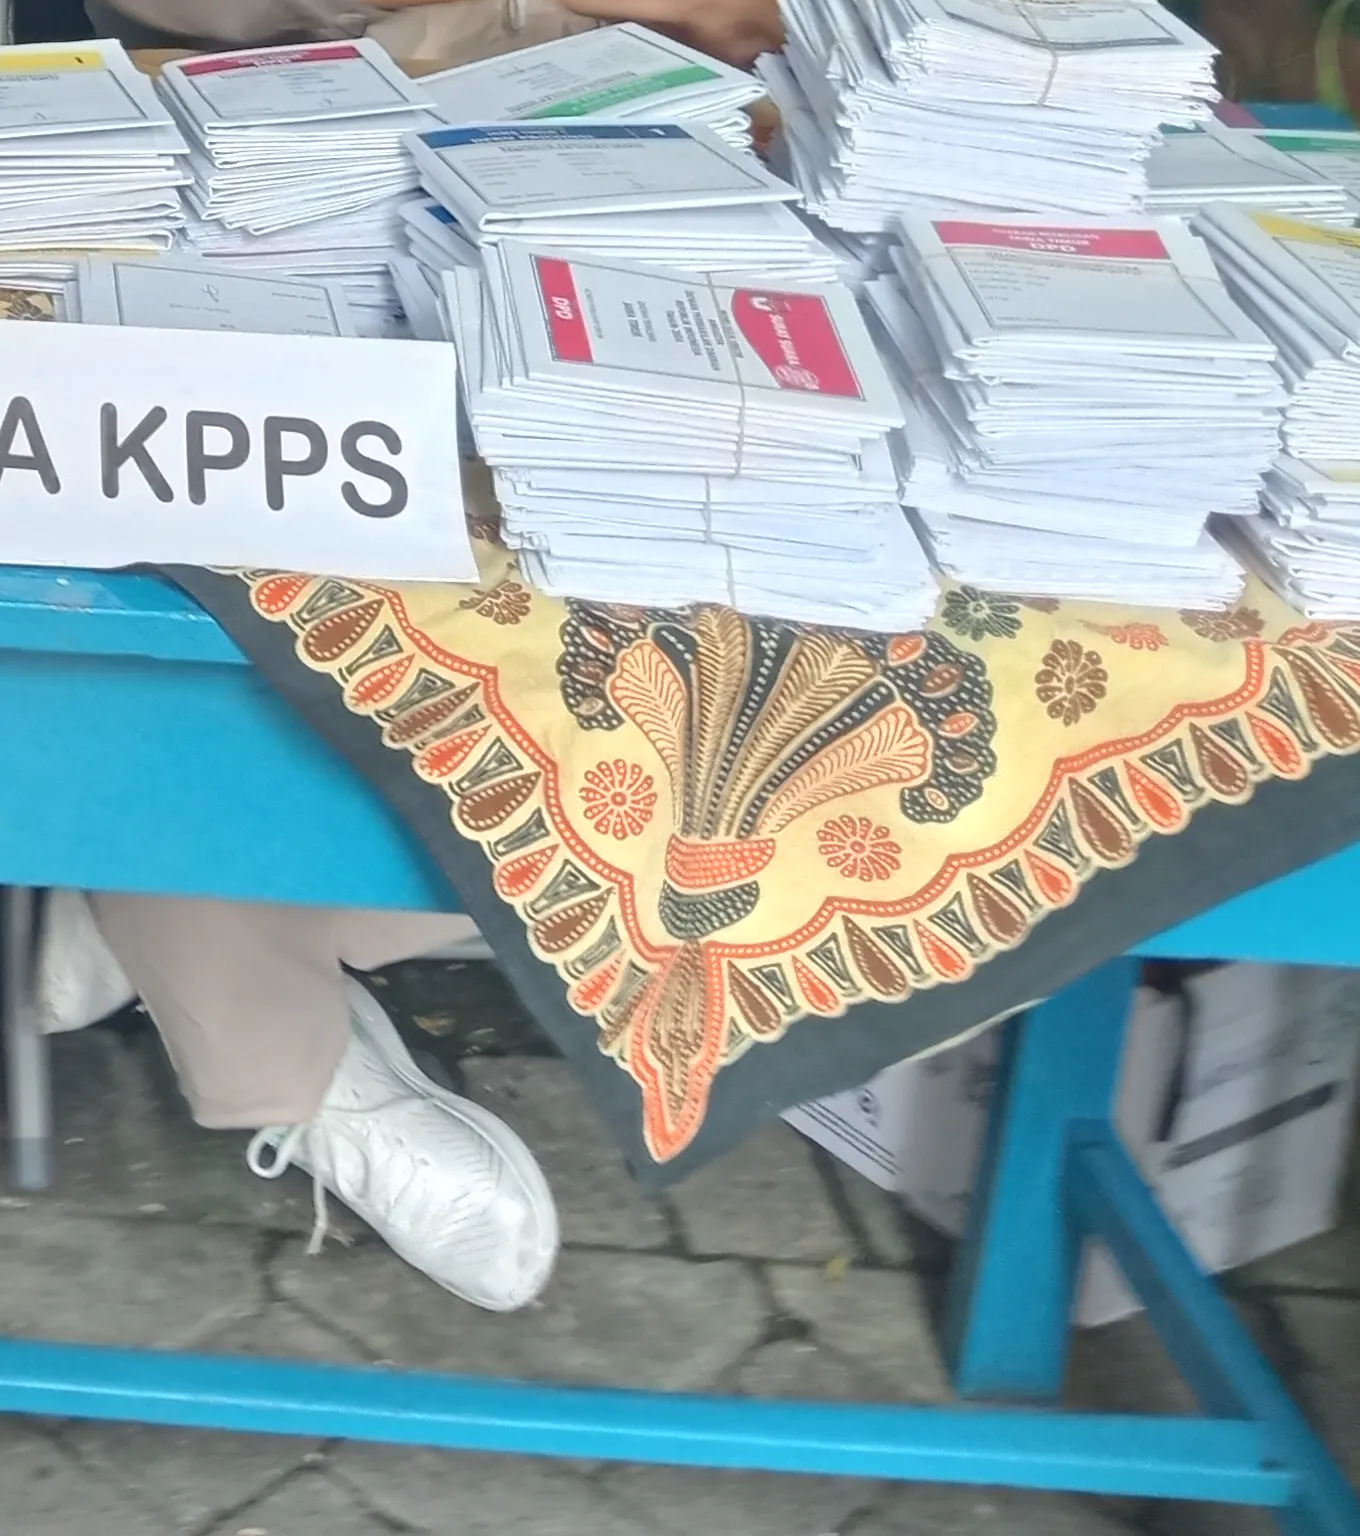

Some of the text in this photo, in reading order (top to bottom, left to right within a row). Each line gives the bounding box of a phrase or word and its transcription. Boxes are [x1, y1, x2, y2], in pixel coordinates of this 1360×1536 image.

[1029, 242, 1077, 253] DPD
[551, 296, 573, 320] DPD
[768, 313, 802, 365] SURAT SUARA
[101, 403, 407, 518] KPPS
